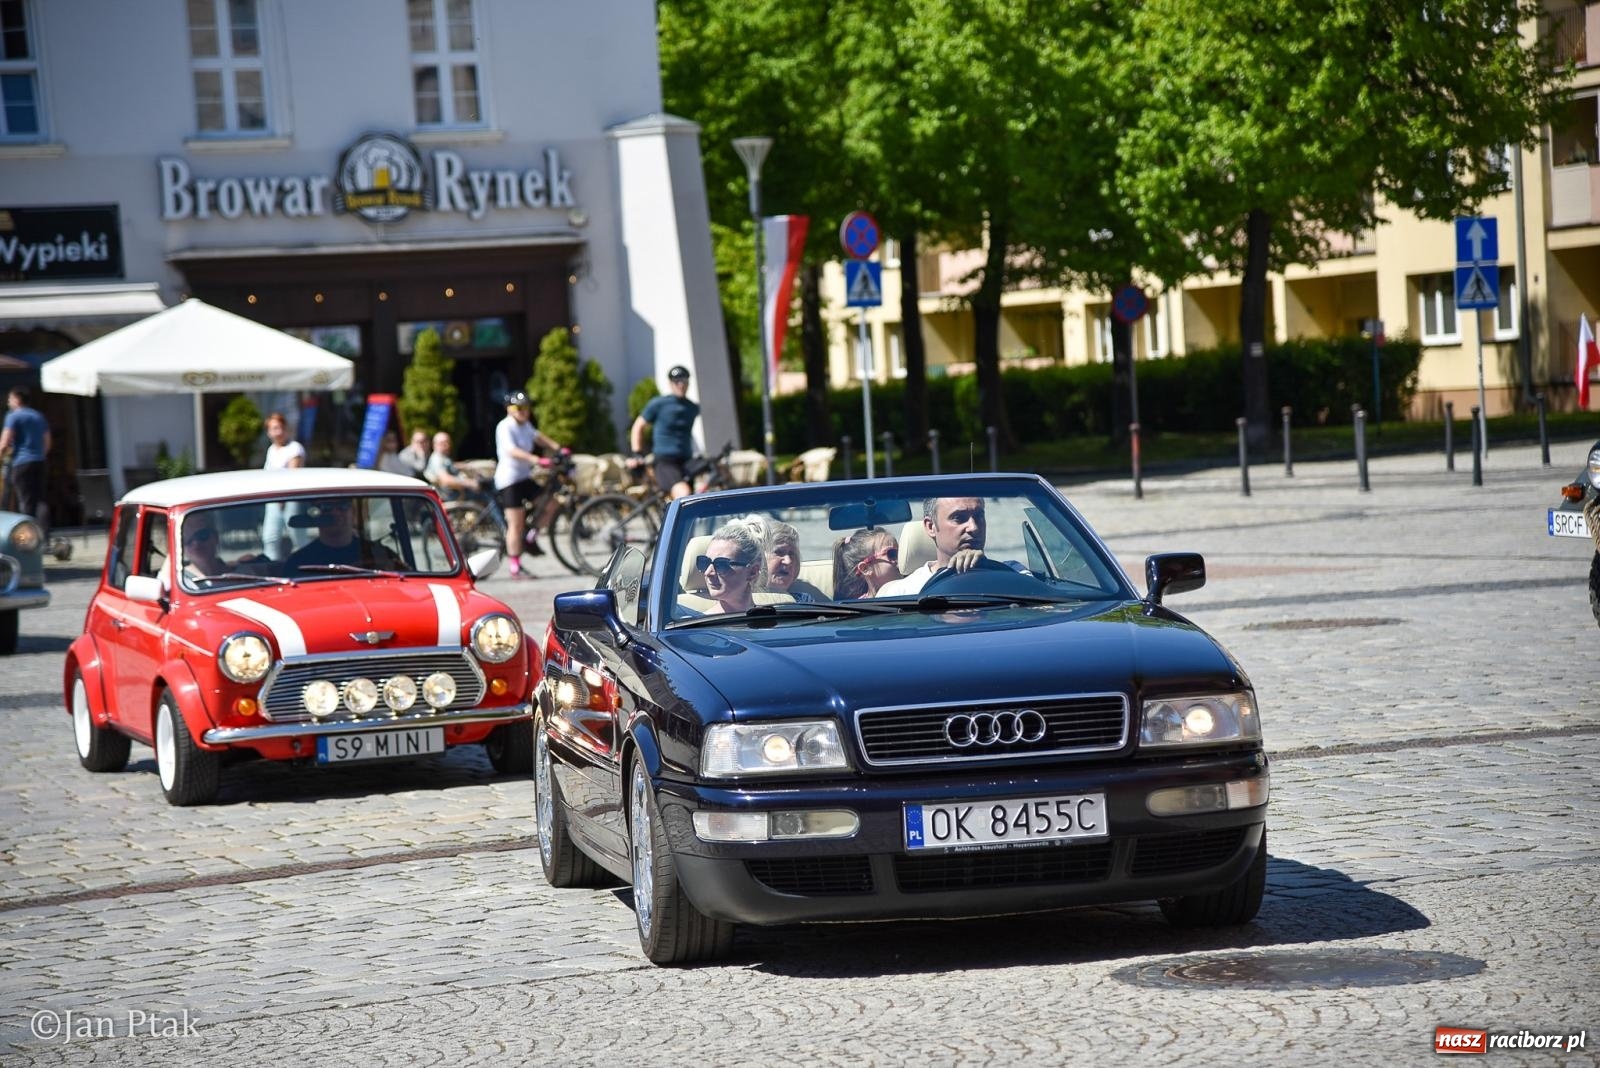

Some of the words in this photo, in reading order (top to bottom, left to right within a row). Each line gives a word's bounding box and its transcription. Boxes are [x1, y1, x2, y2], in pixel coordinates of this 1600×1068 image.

[158, 156, 329, 220] Browar
[434, 148, 576, 220] Rynek
[1555, 514, 1574, 534] SRC
[334, 736, 363, 760] S9
[375, 730, 430, 757] MINI
[931, 805, 976, 841] OK
[990, 798, 1097, 837] 8455C
[909, 830, 923, 841] PL
